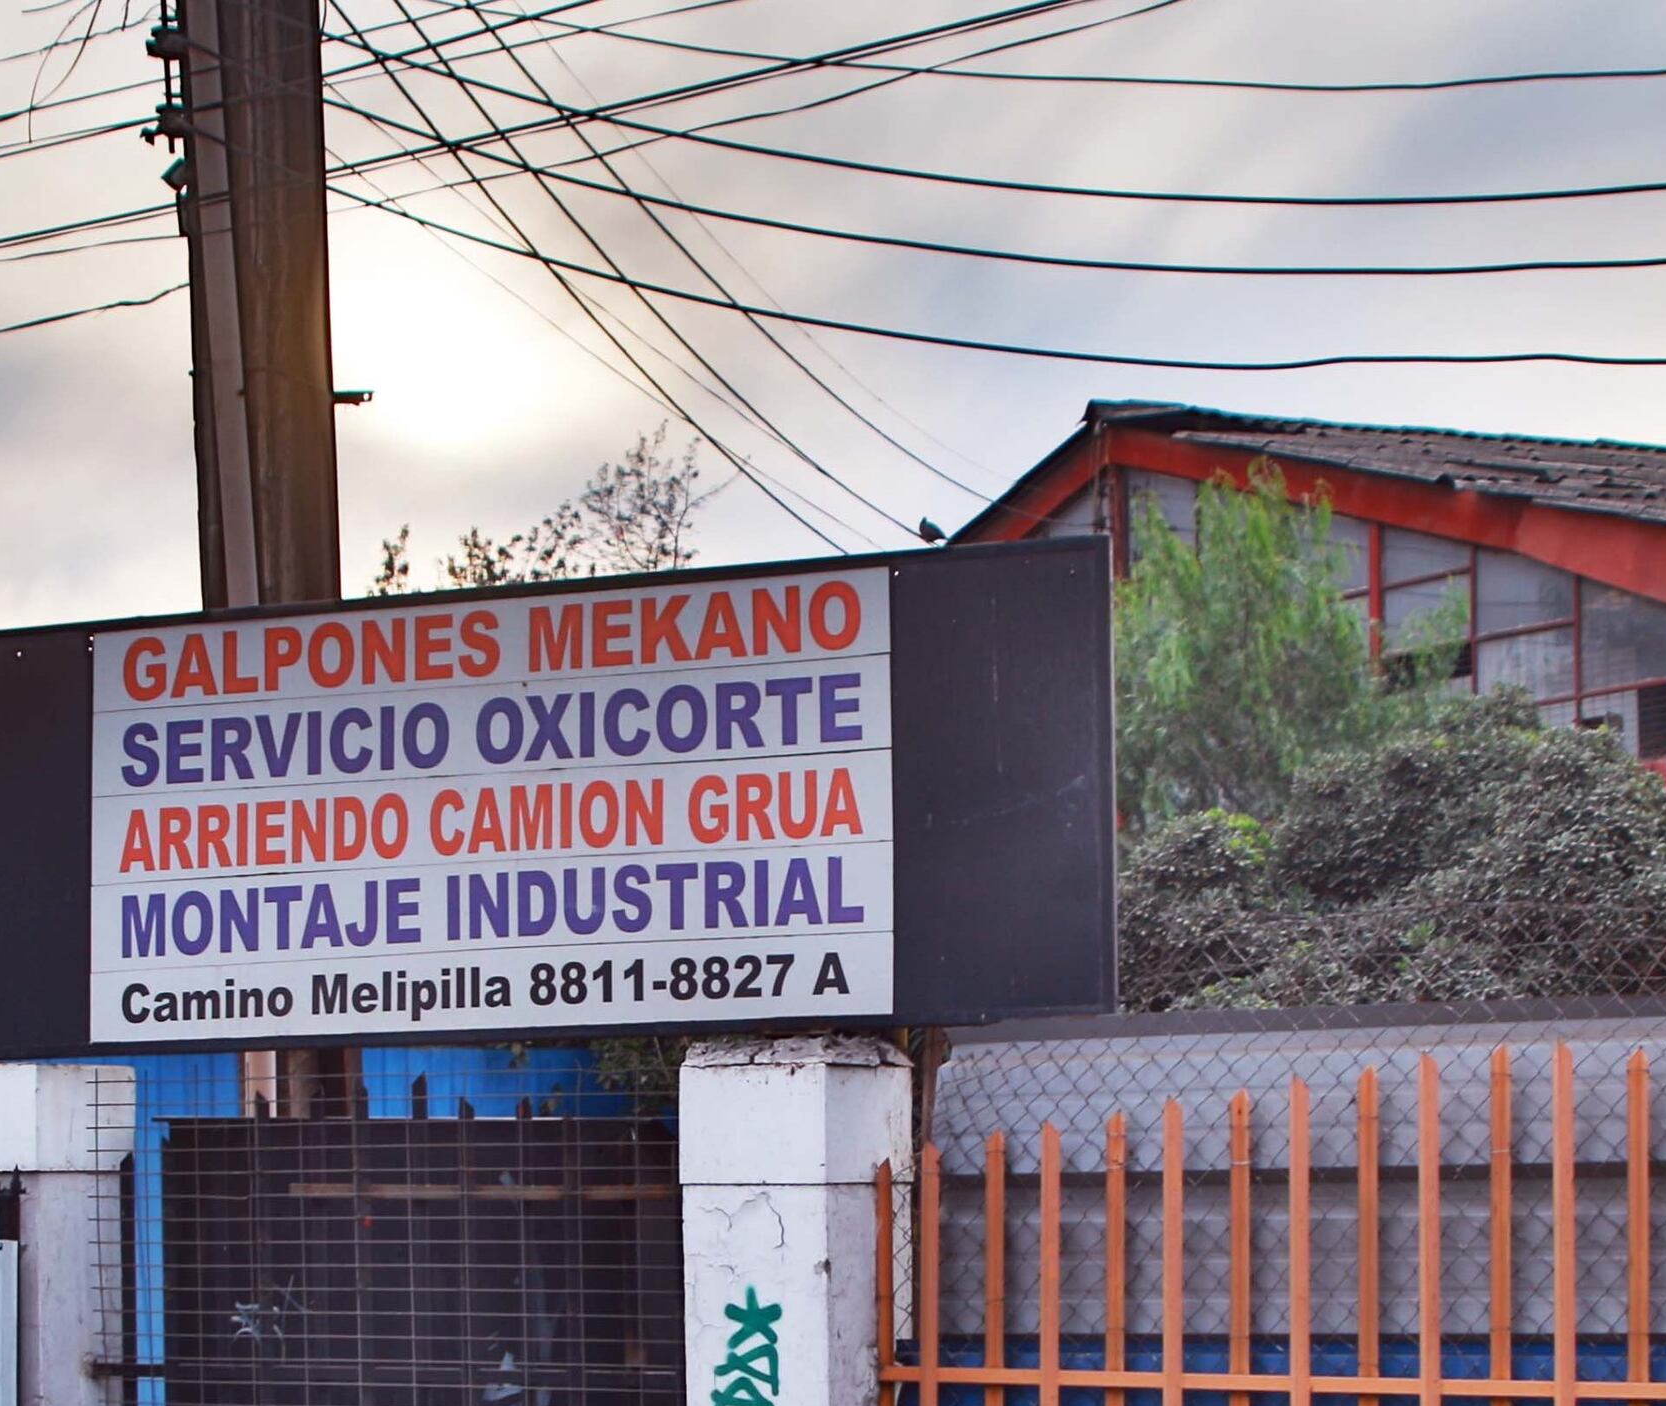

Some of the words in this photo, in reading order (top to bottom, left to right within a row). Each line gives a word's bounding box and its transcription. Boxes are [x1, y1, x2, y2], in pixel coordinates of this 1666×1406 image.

[122, 608, 503, 702] GALPONES
[528, 579, 862, 675] MEKANO
[120, 701, 451, 788] SERVICIO
[475, 672, 864, 765] OXICORTE
[119, 792, 410, 874] ARRIENDO
[429, 778, 665, 857] CAMION
[687, 767, 864, 845] GRUA
[121, 877, 422, 959] MONTAJE
[446, 855, 865, 941] INDUSTRIAL
[121, 978, 295, 1024] Camino
[311, 965, 513, 1022] Melipilla
[529, 953, 796, 1006] 8811-8827
[812, 951, 851, 996] A
